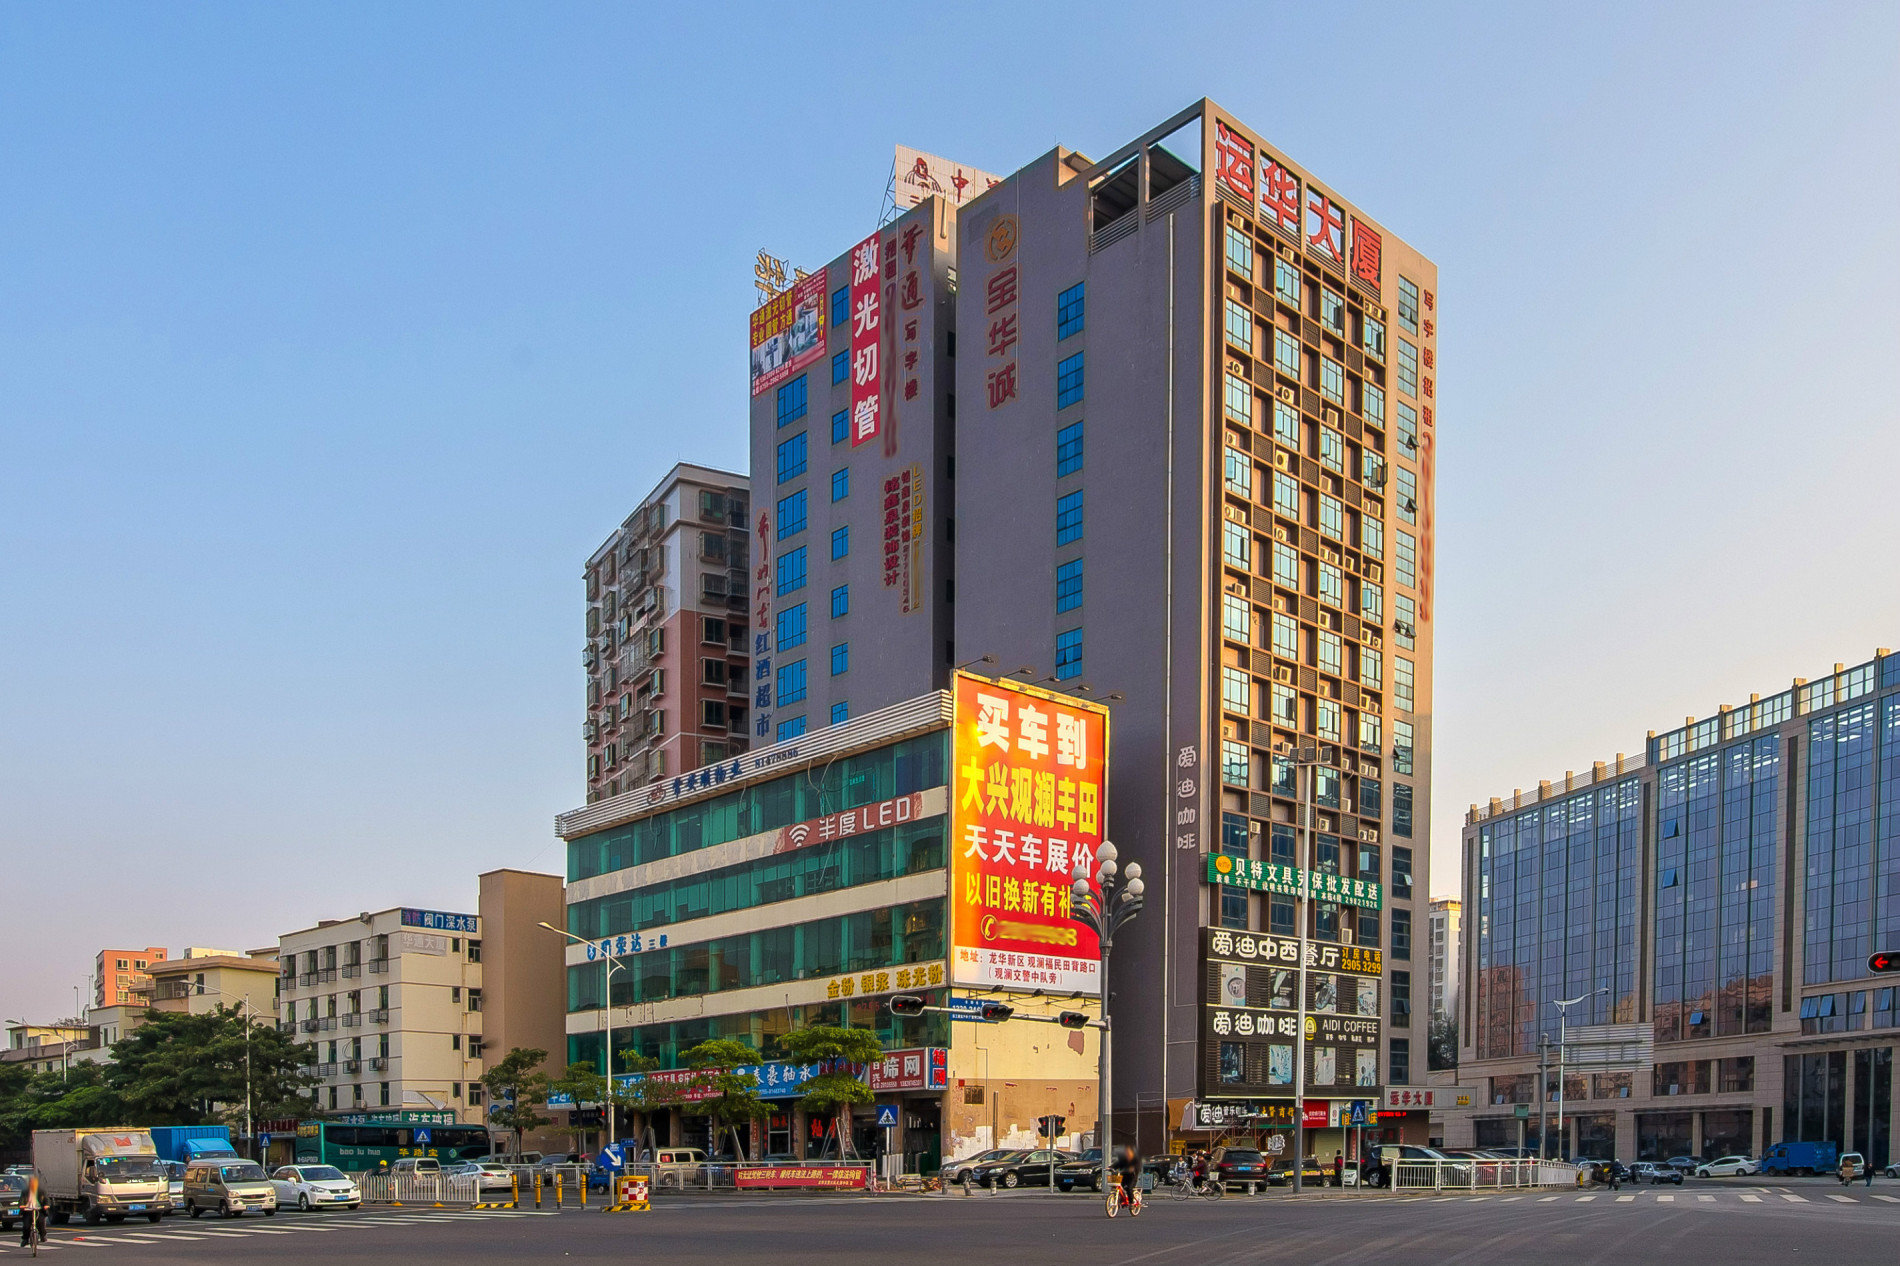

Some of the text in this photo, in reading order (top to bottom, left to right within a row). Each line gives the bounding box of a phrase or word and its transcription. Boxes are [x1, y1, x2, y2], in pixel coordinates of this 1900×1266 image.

[1216, 122, 1382, 290] 运华大厦
[853, 238, 879, 441] 激光切管
[987, 266, 1017, 408] 宝华诚
[755, 631, 771, 738] 红酒超市
[976, 692, 1087, 770] 买车到
[961, 755, 1098, 836] 大兴观澜丰田
[1177, 745, 1197, 850] 爱迪咖啡
[819, 797, 911, 840] 半度LED
[964, 824, 1094, 879] 天天车展价
[966, 872, 1091, 919] 以旧换新有补
[424, 912, 476, 932] 阀门深水泵
[989, 952, 1025, 967] 龙华新区
[1027, 956, 1096, 973] 观澜福民田背路口
[1212, 931, 1340, 967] 爱迪中西餐厅
[1342, 947, 1382, 962] 订房电话
[1342, 959, 1382, 974] 2905 3299
[827, 977, 855, 998] 金粉
[896, 963, 944, 989] 珠光粉
[1213, 1011, 1378, 1037] 爱迪咖啡 AIDI COFFEE
[882, 1054, 921, 1079] 筛网
[1390, 1091, 1433, 1106] 运华大厦
